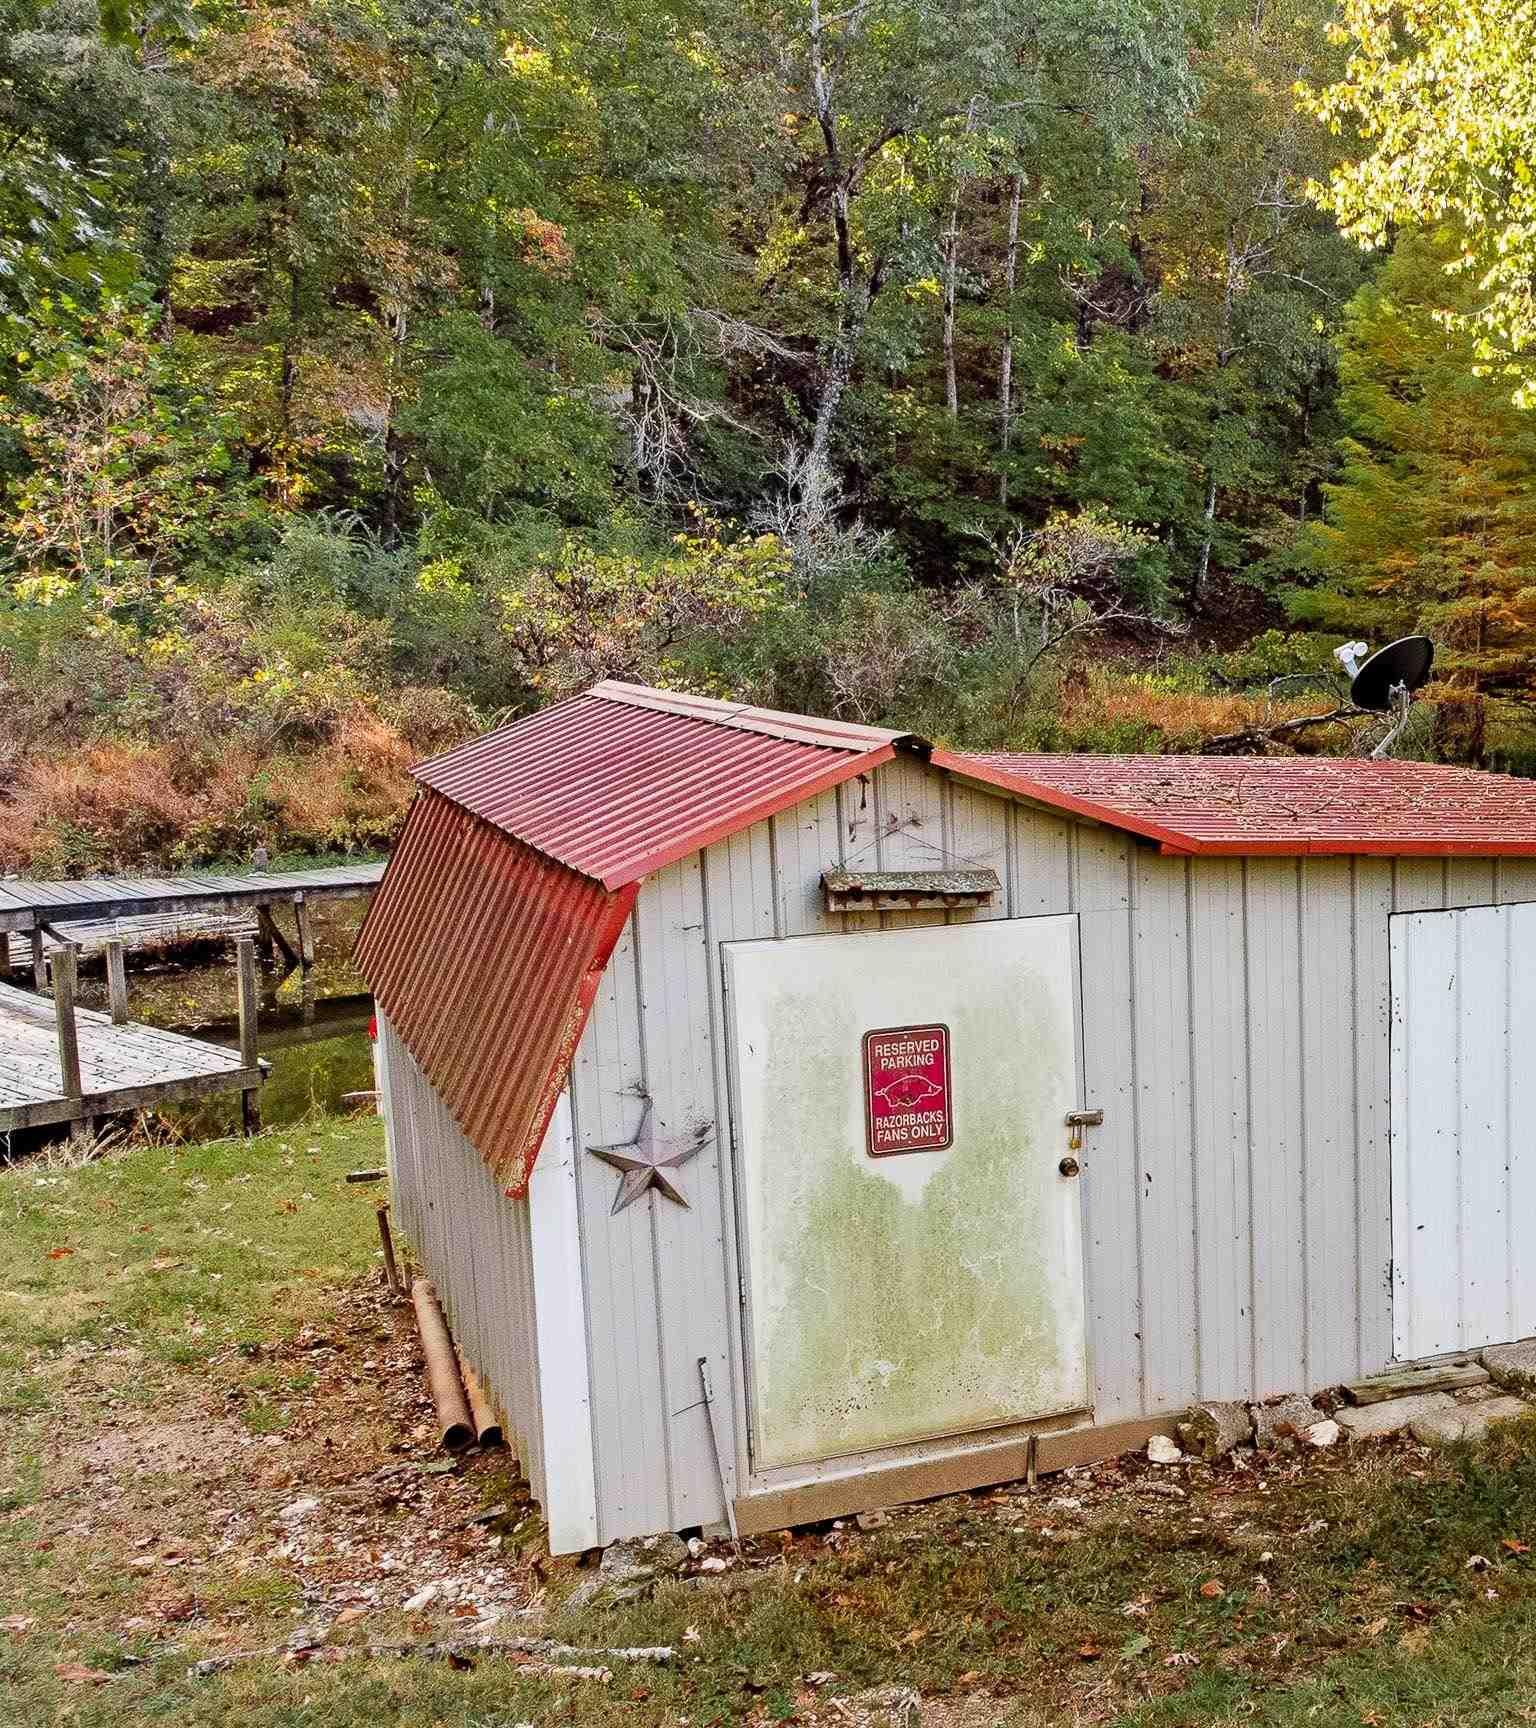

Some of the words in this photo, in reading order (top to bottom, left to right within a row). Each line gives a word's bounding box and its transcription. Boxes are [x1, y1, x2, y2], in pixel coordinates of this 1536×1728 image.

[875, 1039, 940, 1057] RESERVED
[880, 1054, 935, 1070] PARKING
[876, 1110, 943, 1130] RAZORBACKS
[877, 1128, 909, 1143] FANS
[911, 1123, 944, 1139] ONLY
